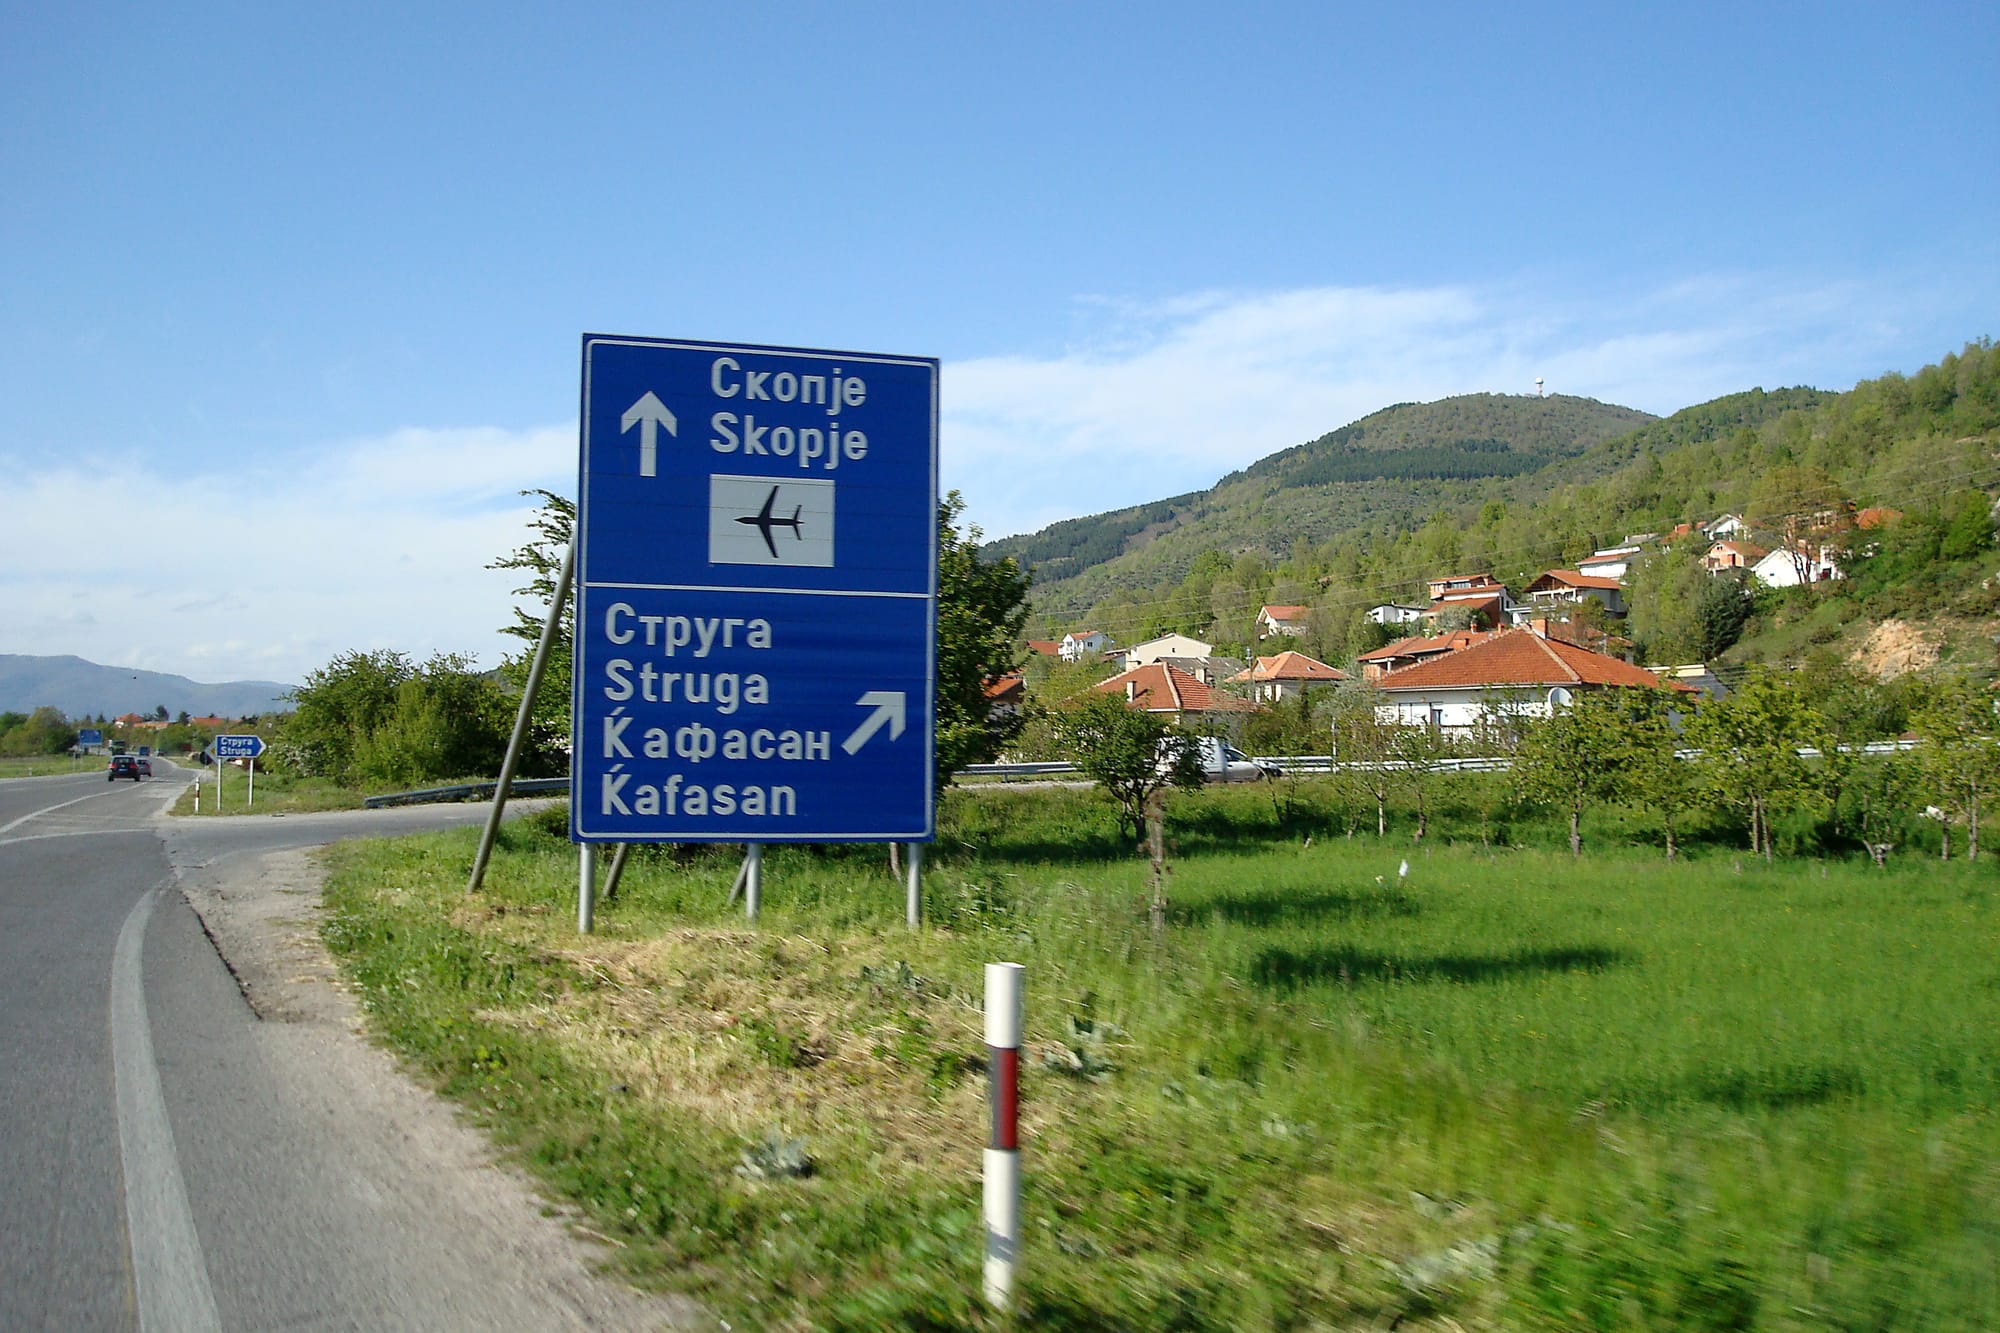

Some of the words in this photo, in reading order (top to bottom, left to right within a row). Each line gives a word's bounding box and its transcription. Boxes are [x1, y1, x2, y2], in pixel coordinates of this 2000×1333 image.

[711, 357, 867, 416] Скопје
[710, 412, 868, 470] Skopje
[605, 602, 772, 658] Струга
[604, 659, 769, 715] Struga
[220, 746, 253, 757] Struga
[603, 706, 831, 763] Ќафасан
